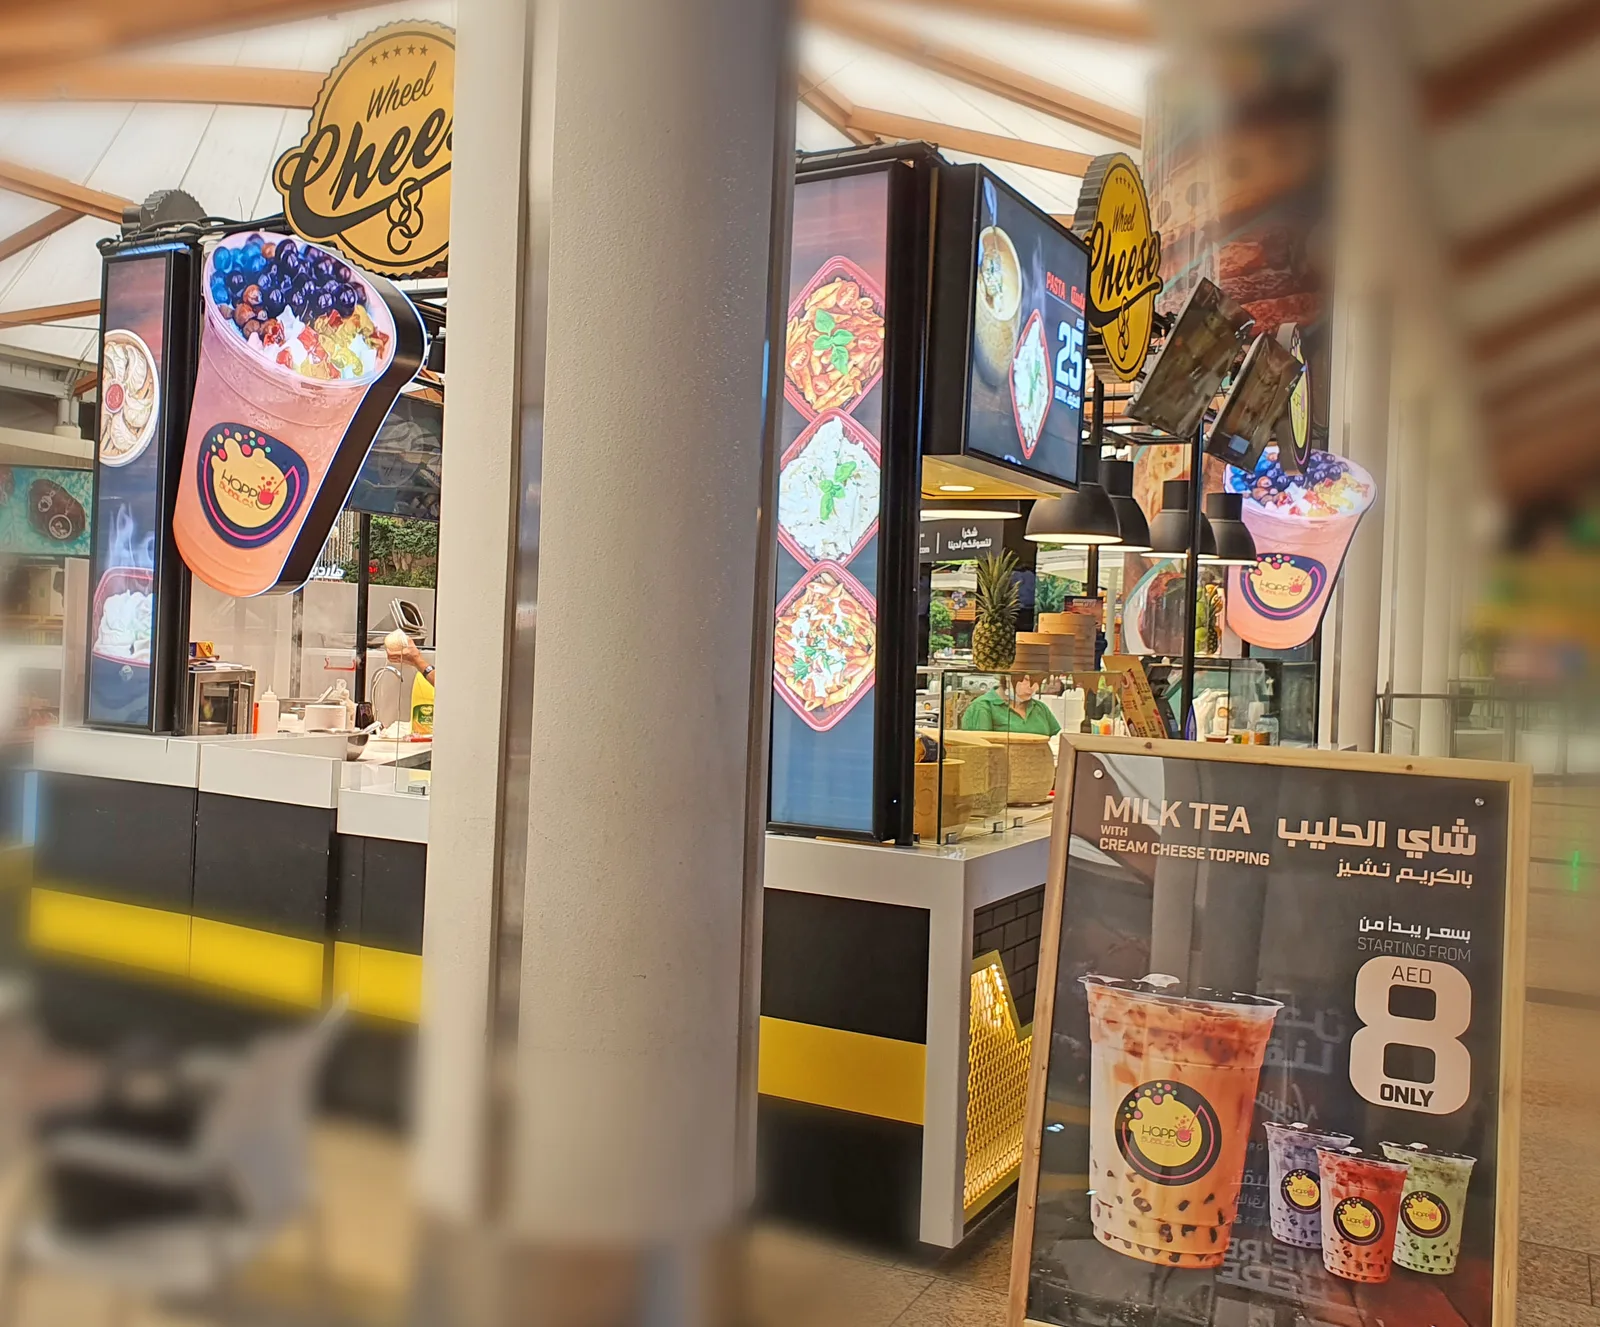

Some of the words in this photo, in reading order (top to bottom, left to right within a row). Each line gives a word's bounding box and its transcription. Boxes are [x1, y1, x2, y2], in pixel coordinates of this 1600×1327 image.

[366, 60, 437, 122] Wheel
[1112, 202, 1136, 233] Wheel
[1046, 271, 1066, 300] PASTA
[1055, 320, 1083, 391] 25
[1103, 795, 1182, 828] MILK
[1188, 802, 1251, 834] TEA
[1100, 825, 1128, 837] WITH
[1277, 817, 1386, 850] الحليب
[1397, 818, 1476, 859] شاي
[1099, 837, 1148, 854] CREAM
[1150, 843, 1205, 860] CHEESE
[1208, 848, 1270, 866] TOPPING
[1336, 858, 1390, 877] تشيز
[1396, 868, 1473, 889] بالكريم
[1359, 916, 1384, 932] من
[1388, 916, 1421, 939] يبدأ
[1425, 925, 1471, 943] بسعر
[1357, 937, 1426, 957] STARTING
[1429, 945, 1471, 962] FROM
[1391, 965, 1432, 984] AED
[1348, 955, 1472, 1115] 8
[1380, 1083, 1435, 1107] ONLY
